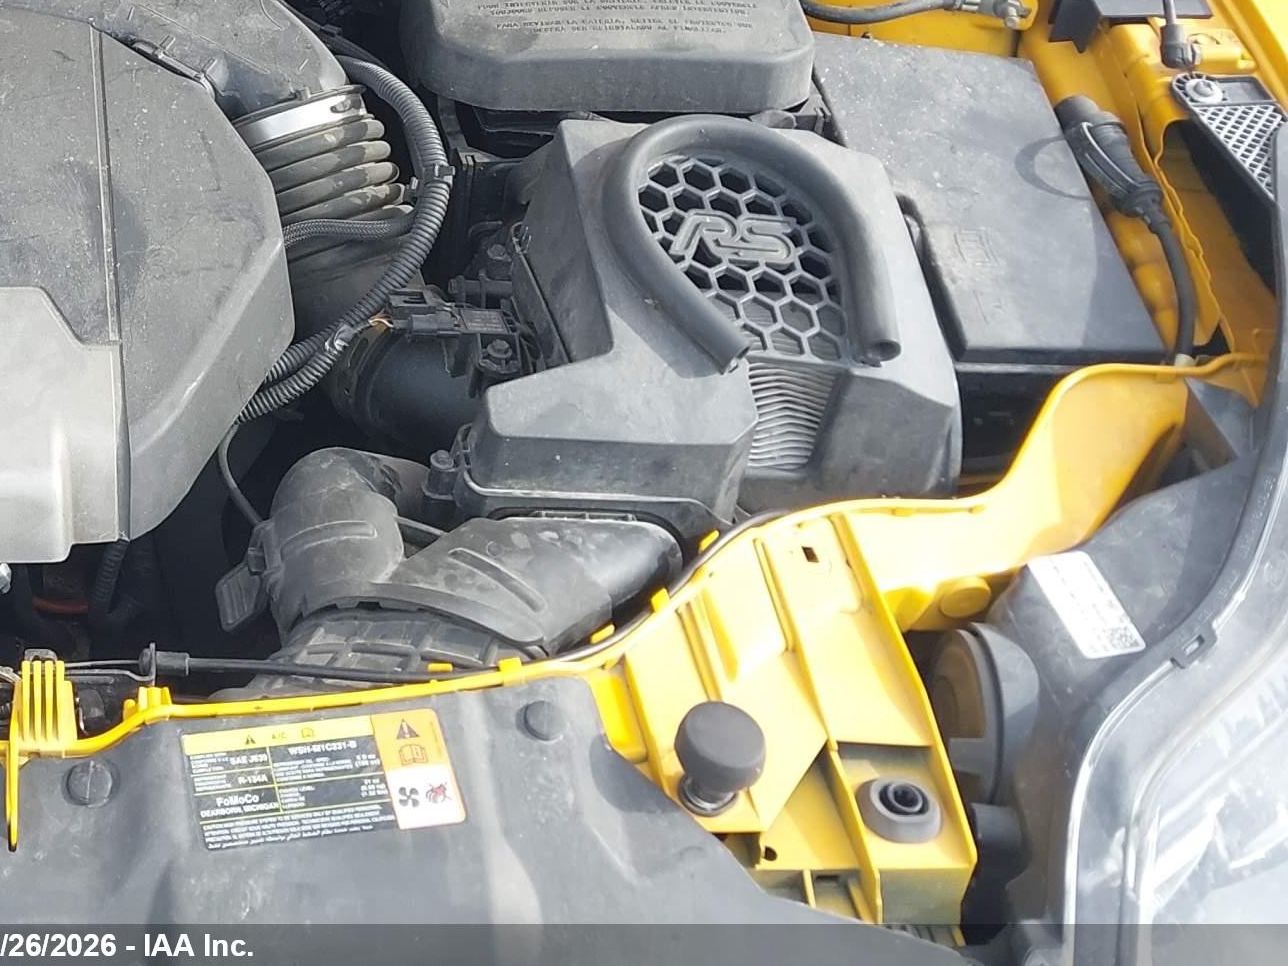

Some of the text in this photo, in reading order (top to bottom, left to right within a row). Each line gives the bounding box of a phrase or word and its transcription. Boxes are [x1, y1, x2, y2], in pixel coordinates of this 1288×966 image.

[669, 209, 796, 265] RS
[230, 756, 248, 765] SAE
[238, 774, 268, 785] R-134A
[216, 794, 259, 807] FoMoCo
